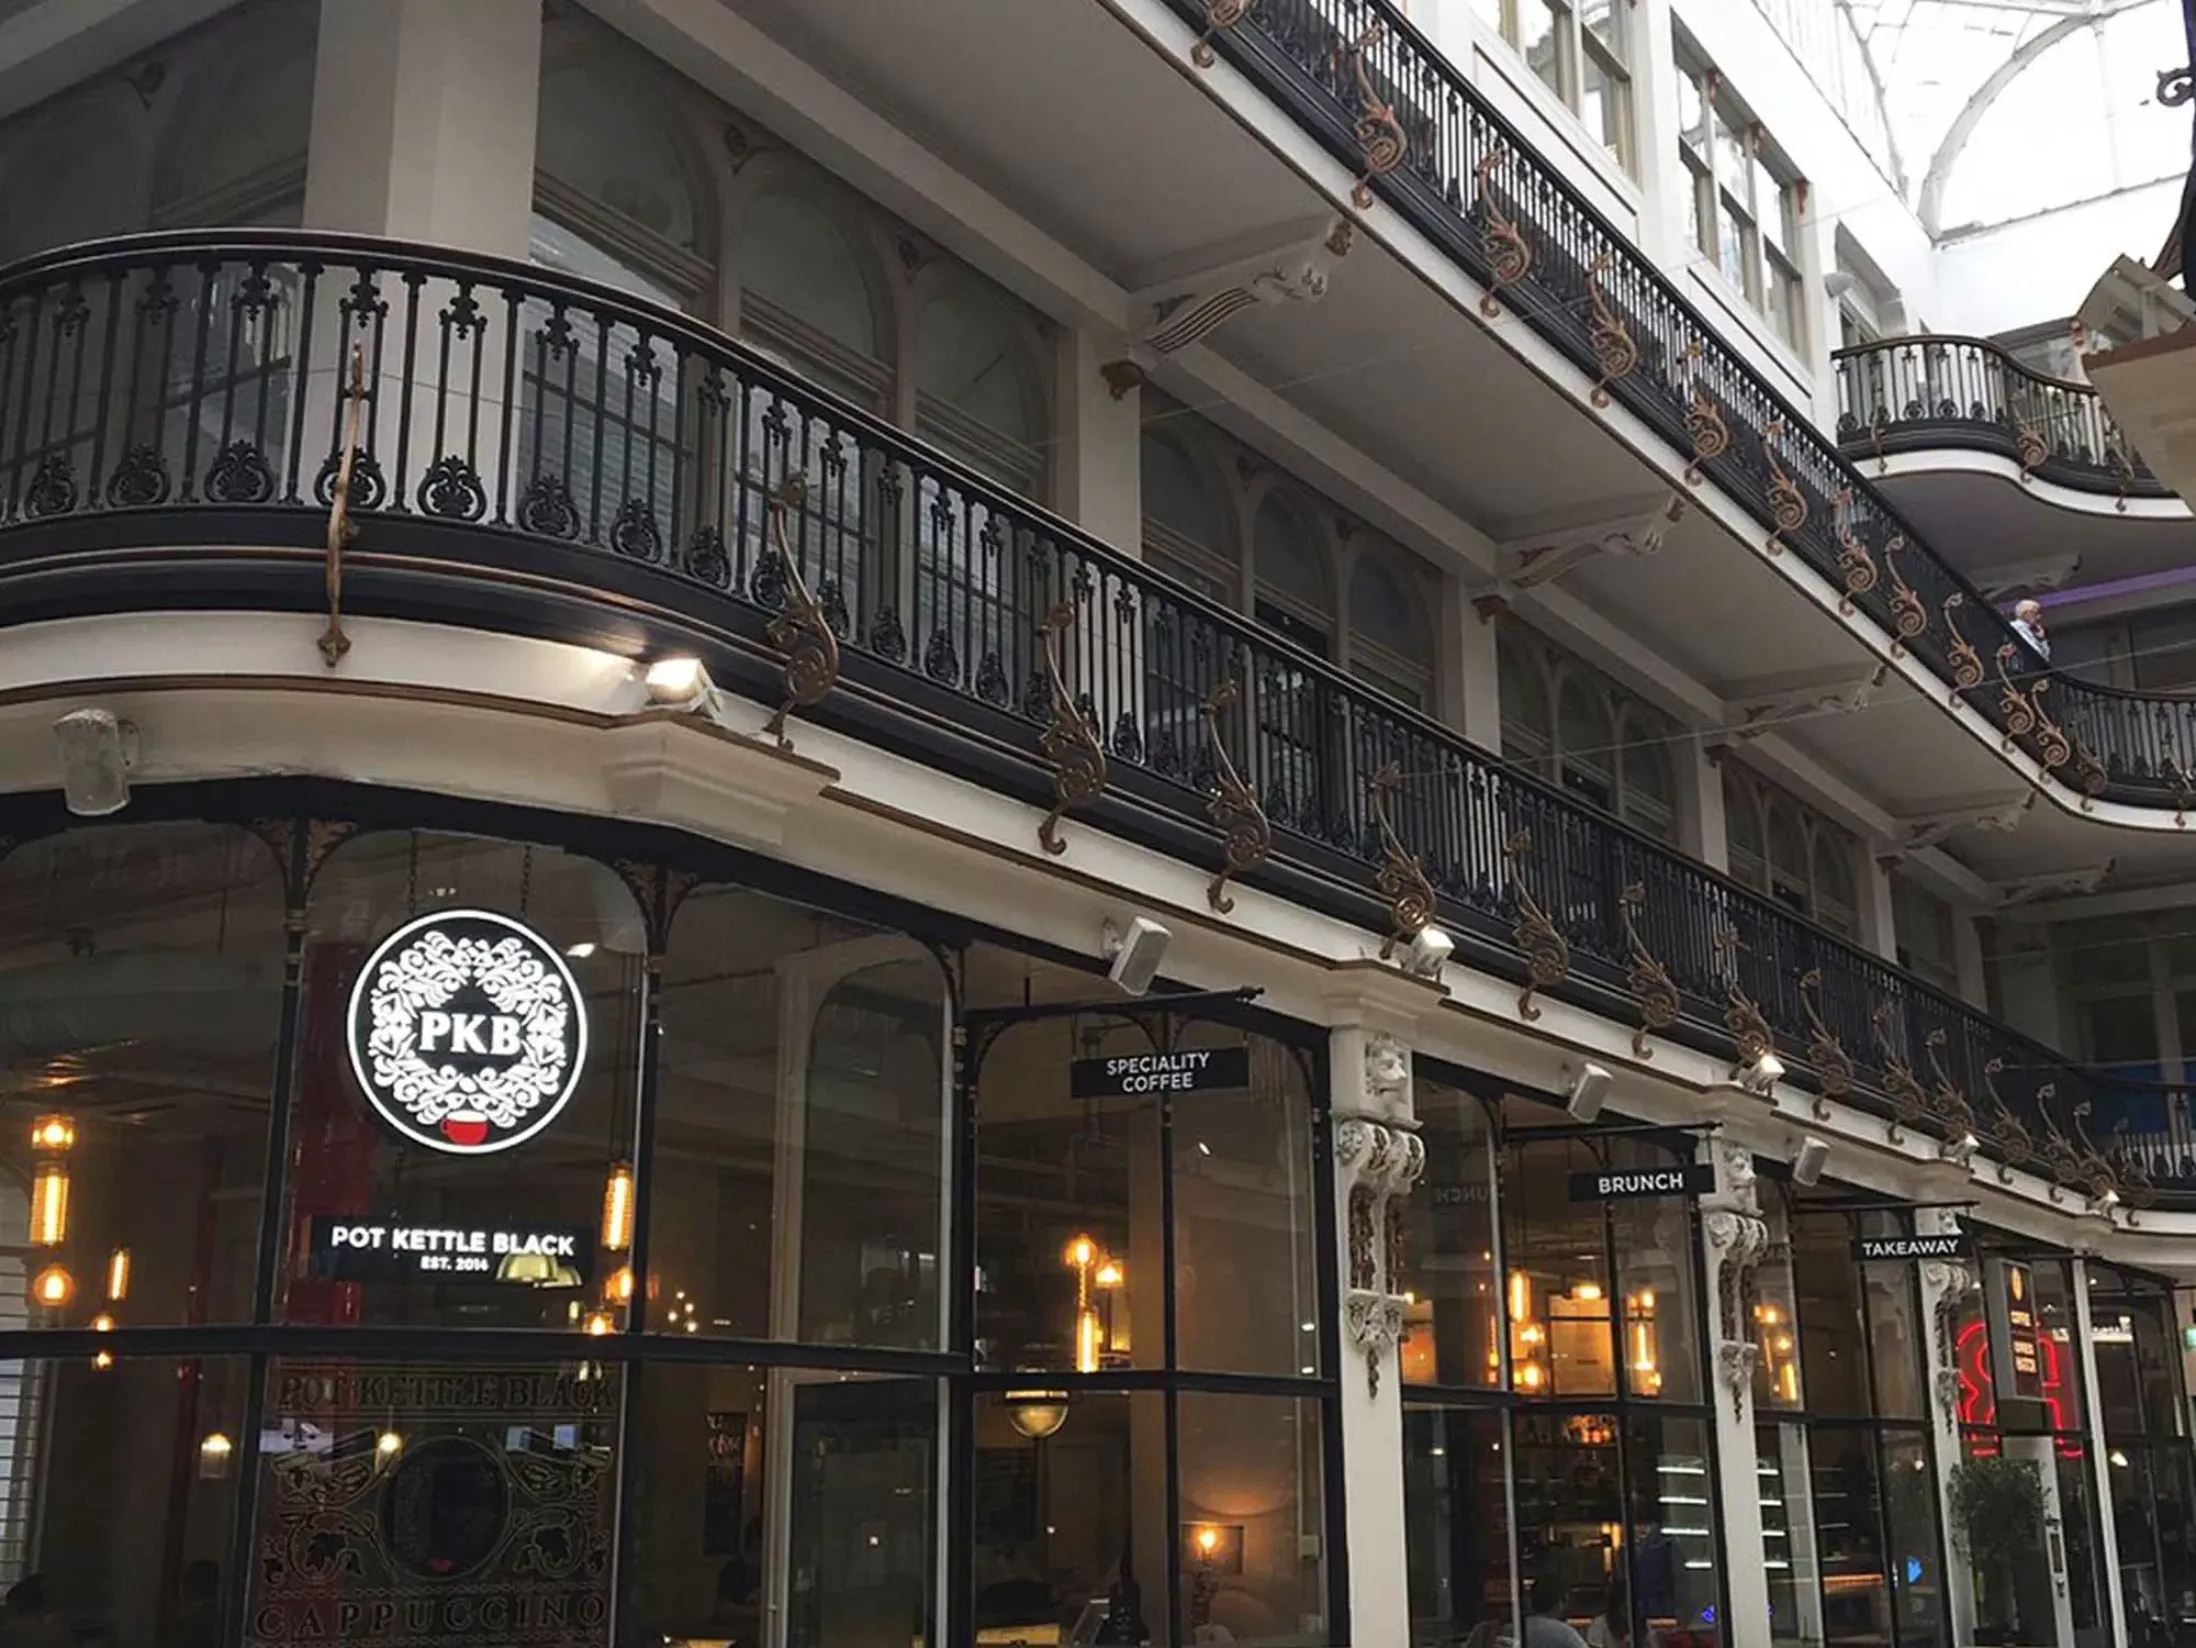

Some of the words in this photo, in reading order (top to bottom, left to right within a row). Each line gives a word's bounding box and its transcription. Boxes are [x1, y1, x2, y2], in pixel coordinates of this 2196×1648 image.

[418, 1010, 520, 1056] PKB
[1106, 1051, 1210, 1076] SPECIALITY
[1122, 1071, 1193, 1092] COFFEE
[1598, 1172, 1684, 1194] BRUNCH
[331, 1226, 386, 1249] POT
[391, 1228, 486, 1252] KETTLE
[492, 1232, 575, 1256] BLACK
[1862, 1239, 1959, 1256] TAKEAWAY
[420, 1256, 452, 1270] EST.
[455, 1257, 489, 1272] 2014
[280, 1374, 346, 1407] POT
[356, 1376, 498, 1408] KETTLE
[503, 1376, 614, 1407] BLACK
[254, 1594, 607, 1639] CAPPUCCINO
